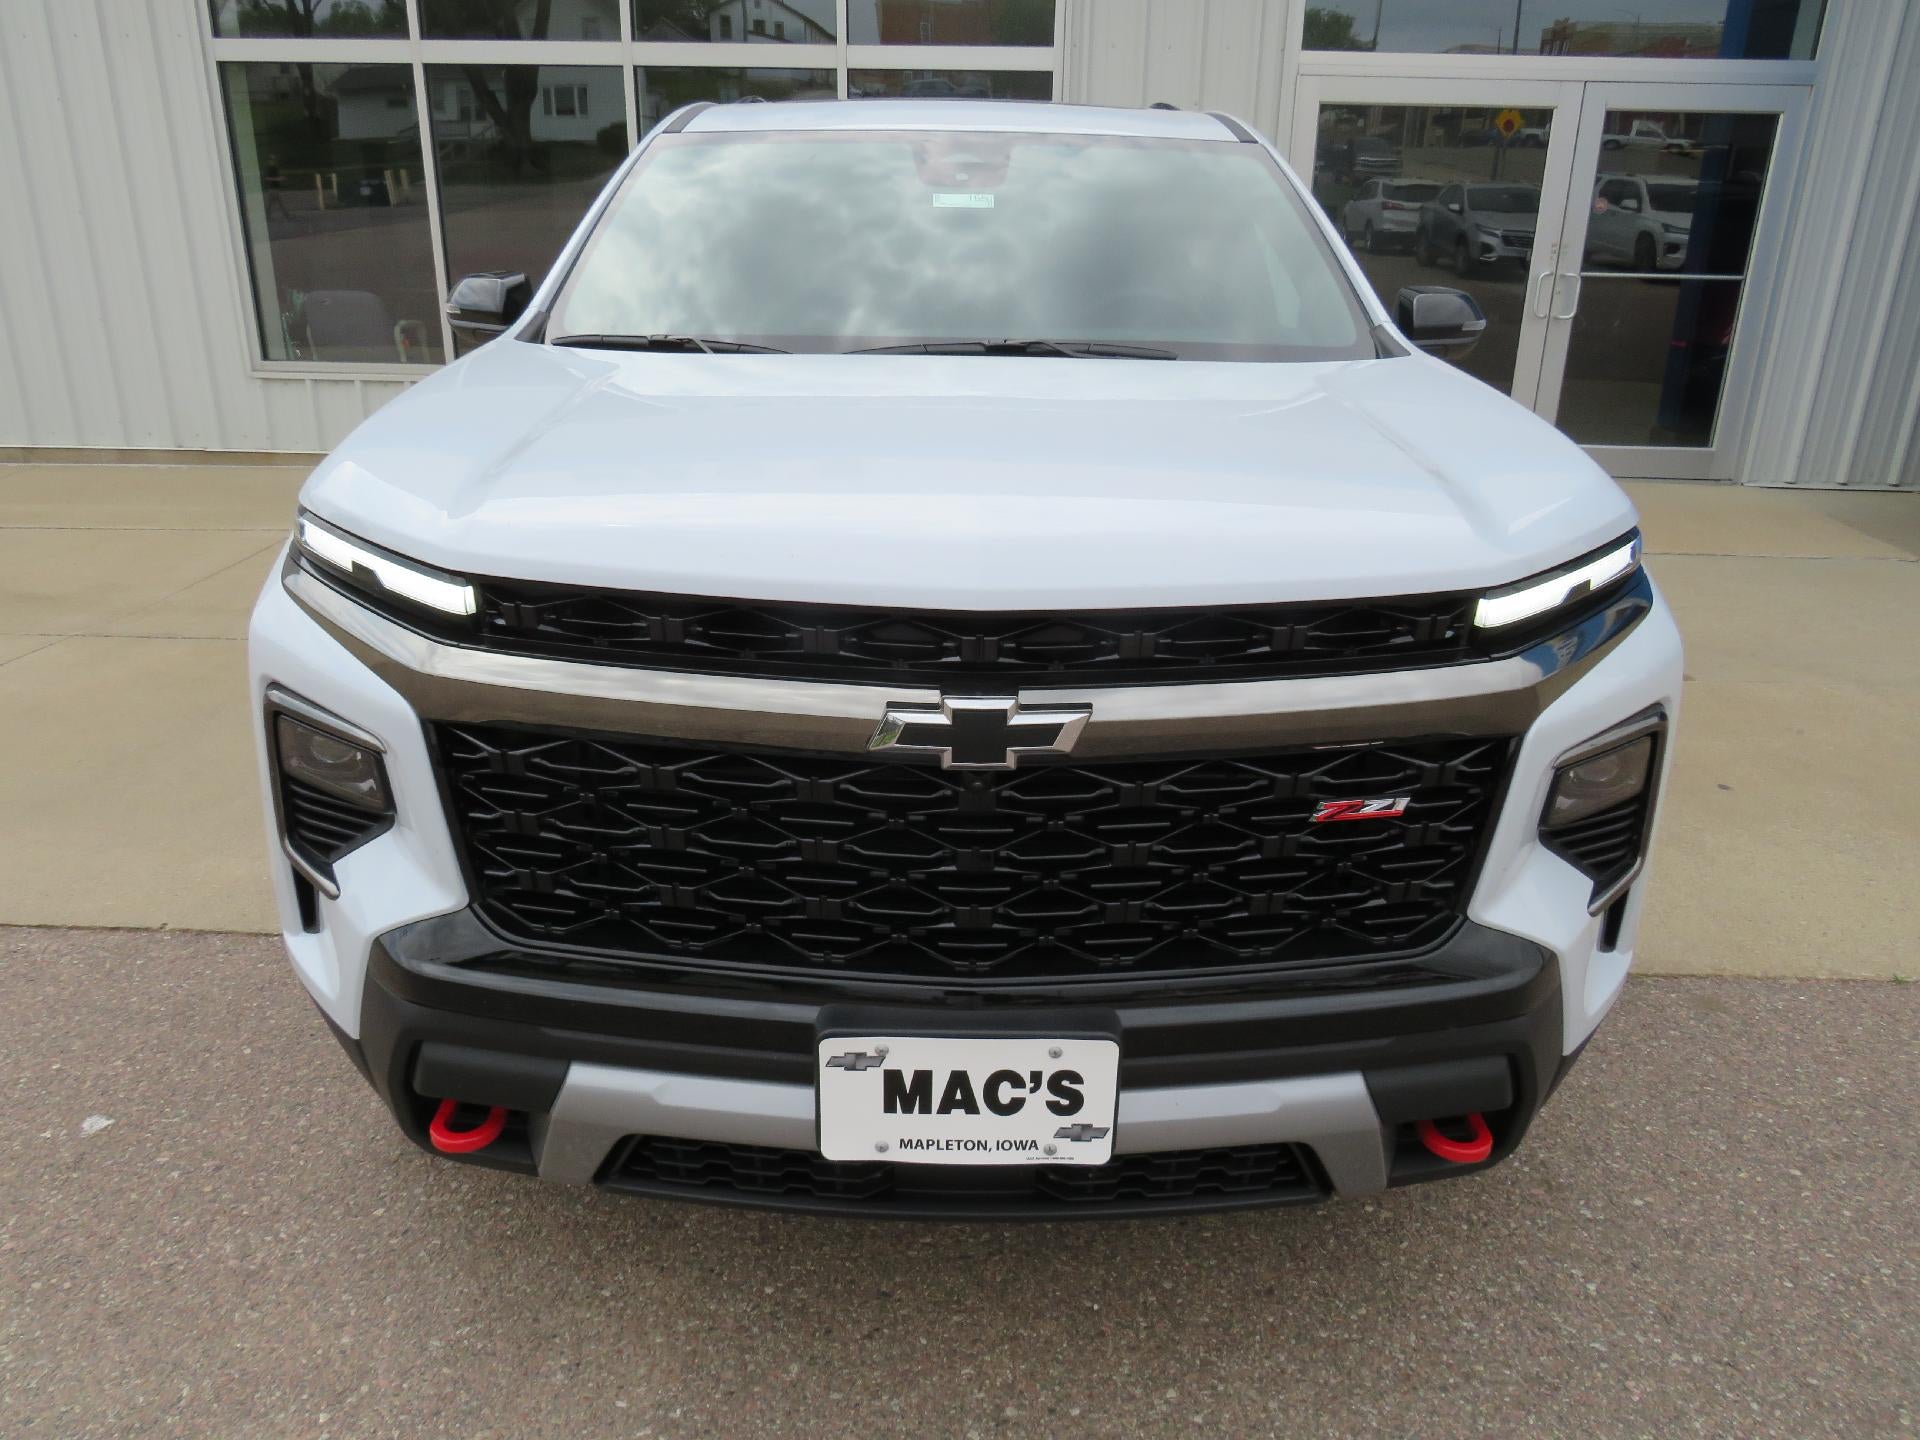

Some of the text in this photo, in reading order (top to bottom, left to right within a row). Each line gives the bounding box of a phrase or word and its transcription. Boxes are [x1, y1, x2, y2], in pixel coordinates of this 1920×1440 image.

[883, 1069, 1085, 1116] MAC'S
[899, 1138, 1039, 1153] MAPLETON, IOWA
